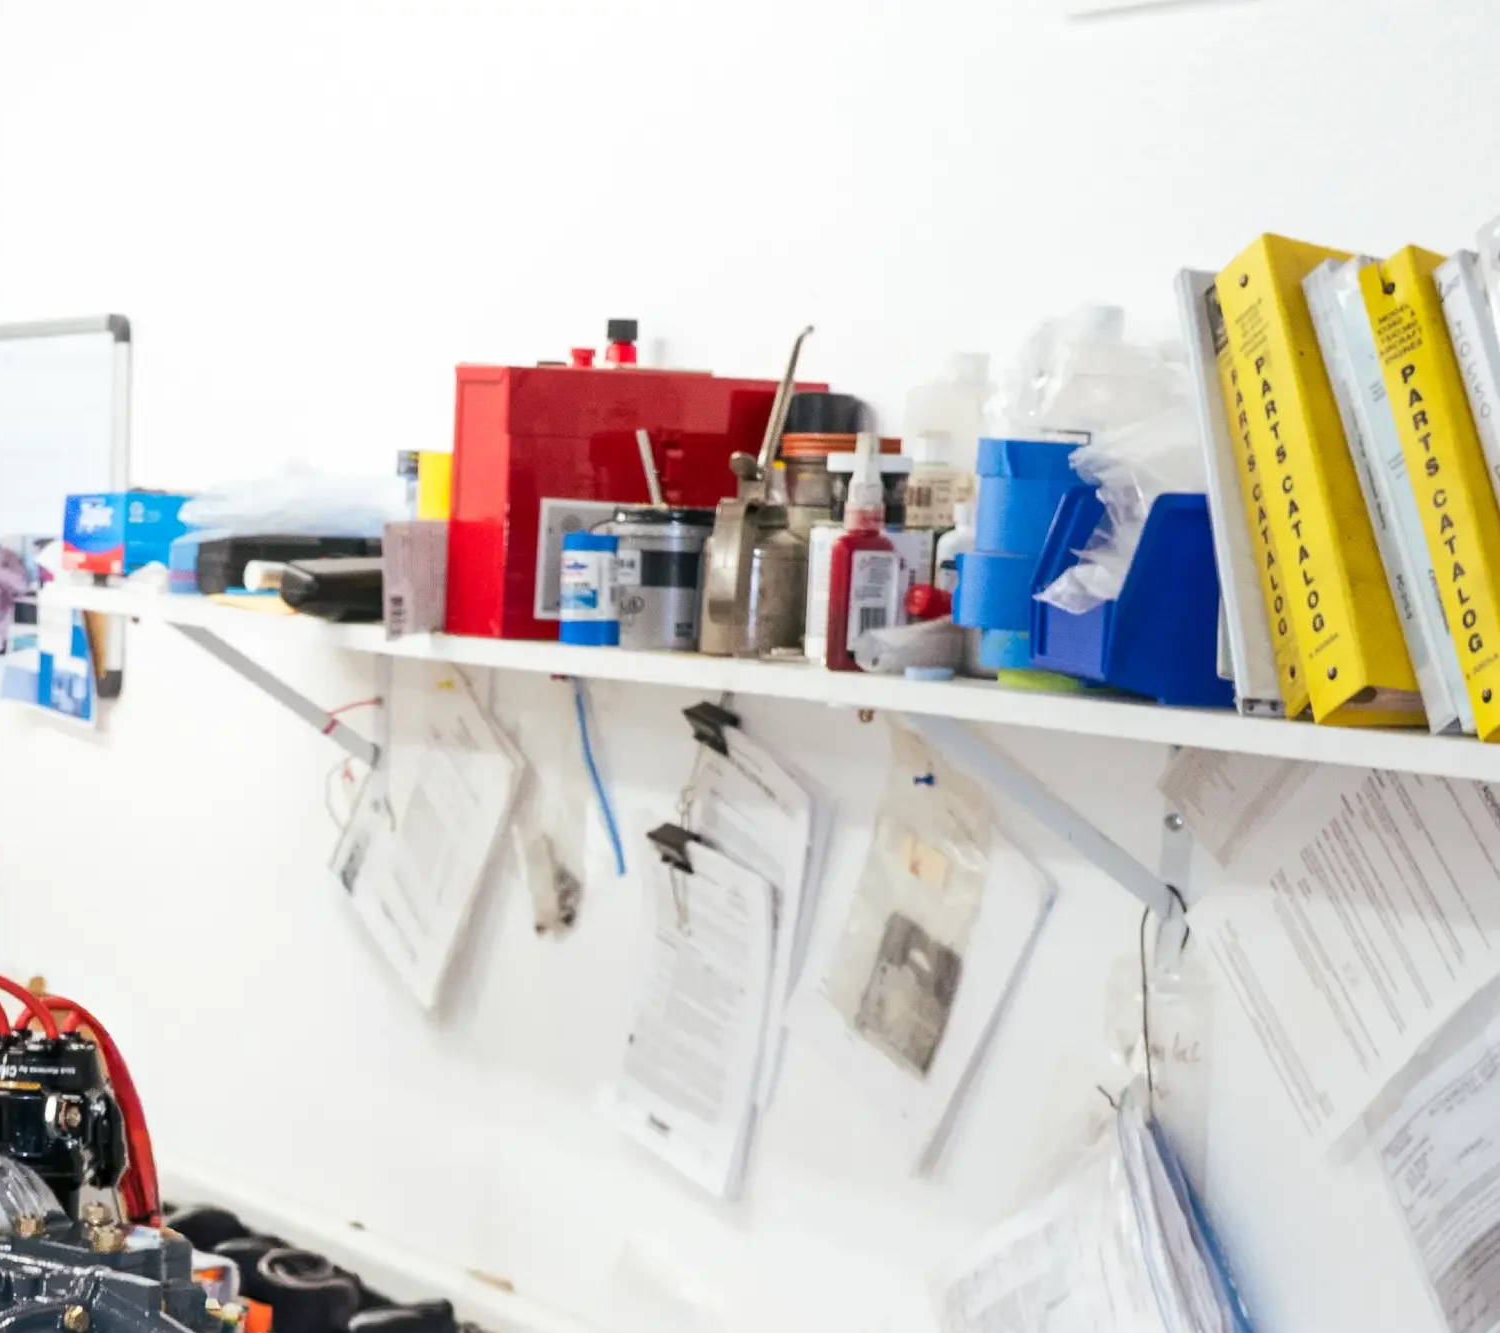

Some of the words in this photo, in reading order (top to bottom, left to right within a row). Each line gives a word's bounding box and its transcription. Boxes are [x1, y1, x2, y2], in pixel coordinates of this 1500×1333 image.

[1230, 368, 1257, 473] PARTS
[1252, 483, 1288, 637] CATALOG
[1254, 355, 1287, 465] PARTS
[1282, 475, 1325, 633] CATALOG
[1400, 364, 1441, 477] PARTS
[1432, 488, 1484, 655] CATALOG
